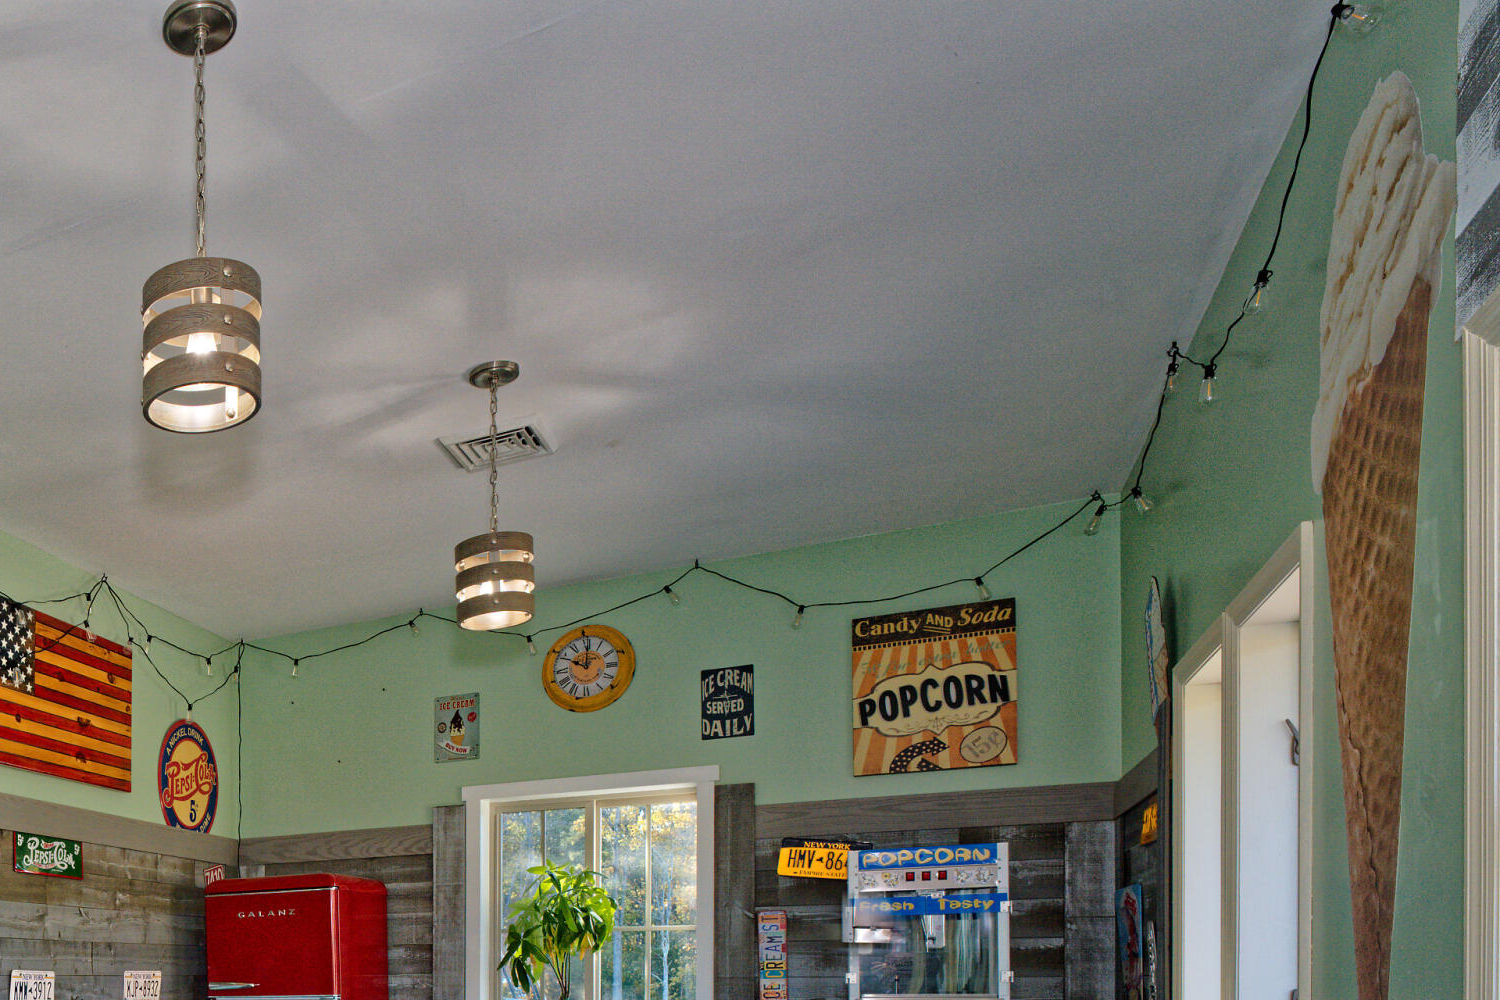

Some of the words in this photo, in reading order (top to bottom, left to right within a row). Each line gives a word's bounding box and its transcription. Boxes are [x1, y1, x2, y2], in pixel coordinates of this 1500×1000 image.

[854, 615, 921, 638] Candy
[925, 613, 954, 628] AND
[957, 605, 1012, 628] Soda
[701, 673, 715, 701] ICE
[716, 668, 754, 697] CREAM
[439, 701, 451, 711] ICE
[452, 698, 475, 710] CREAM
[706, 698, 745, 716] SERVED
[858, 673, 1011, 727] POPCORN
[702, 712, 753, 737] DAILY
[168, 727, 187, 749] NICKEL
[187, 727, 204, 746] DRINK
[803, 841, 826, 849] NEW
[827, 842, 851, 851] YORK
[862, 847, 991, 868] POPCORN
[238, 908, 296, 919] GALANZ
[860, 900, 915, 912] Fresh
[937, 898, 996, 911] Tasty
[764, 935, 784, 978] CREAM
